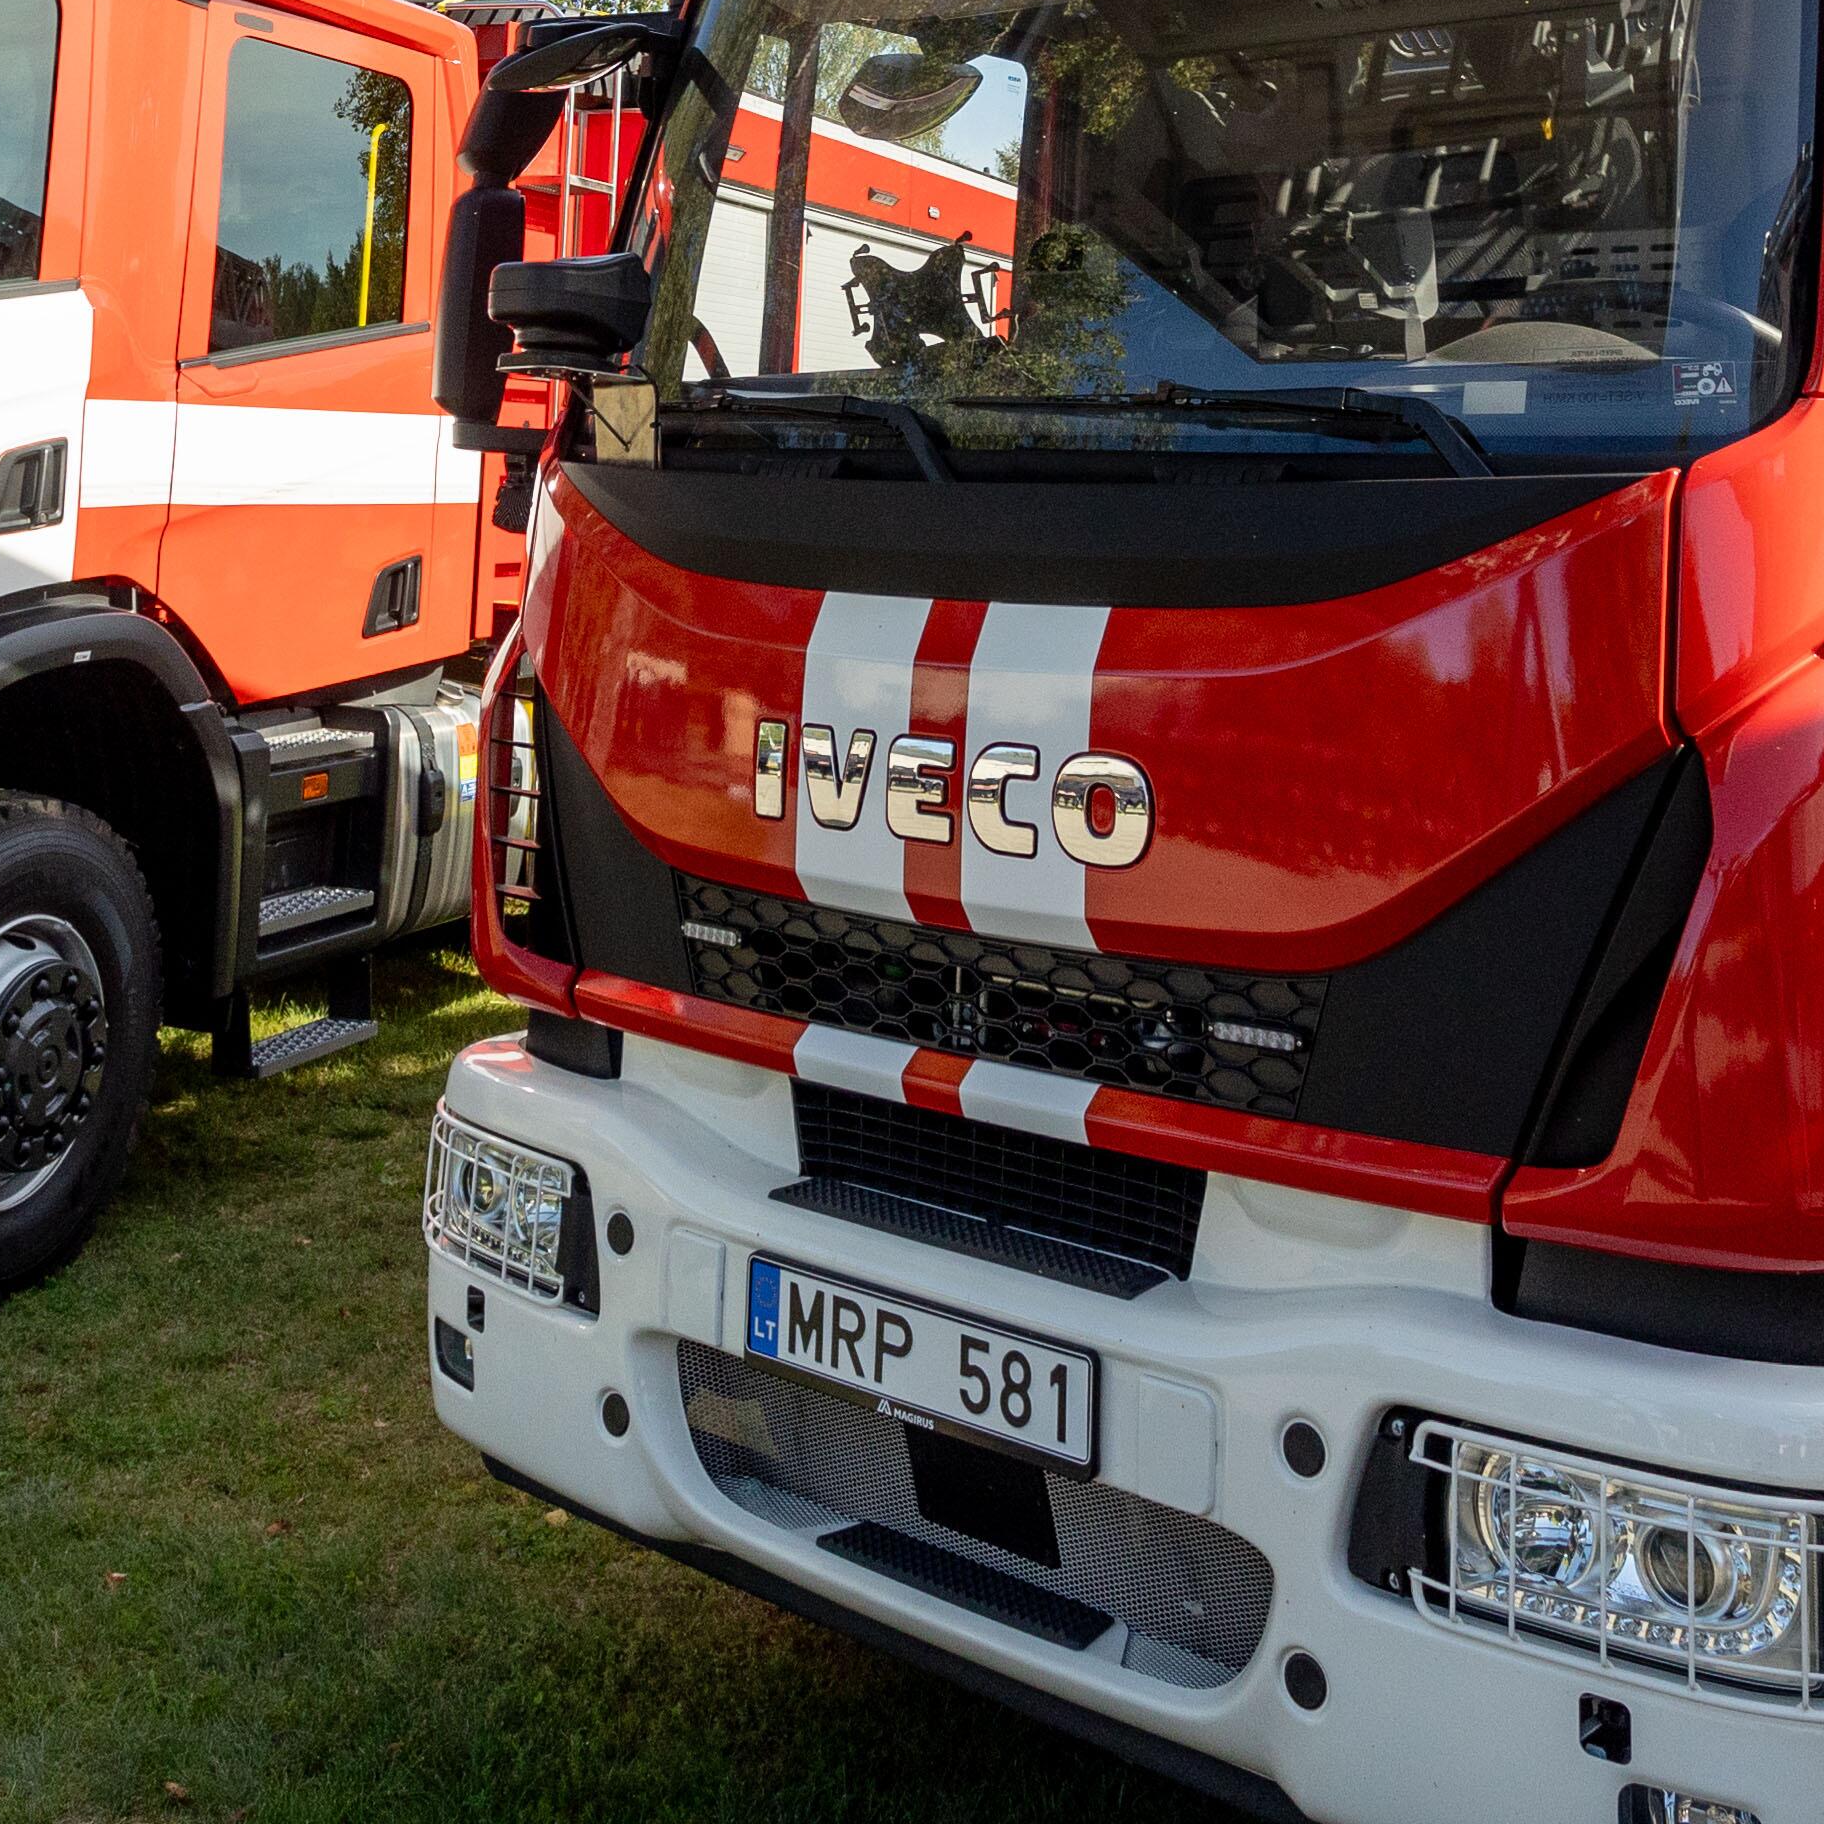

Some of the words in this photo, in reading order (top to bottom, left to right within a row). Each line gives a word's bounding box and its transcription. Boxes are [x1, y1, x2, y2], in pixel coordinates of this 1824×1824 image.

[754, 719, 1155, 868] IVECO
[754, 1317, 776, 1341] LT
[788, 1281, 914, 1384] MRP
[959, 1333, 1069, 1444] 581
[893, 1407, 936, 1431] MAGIRUS
